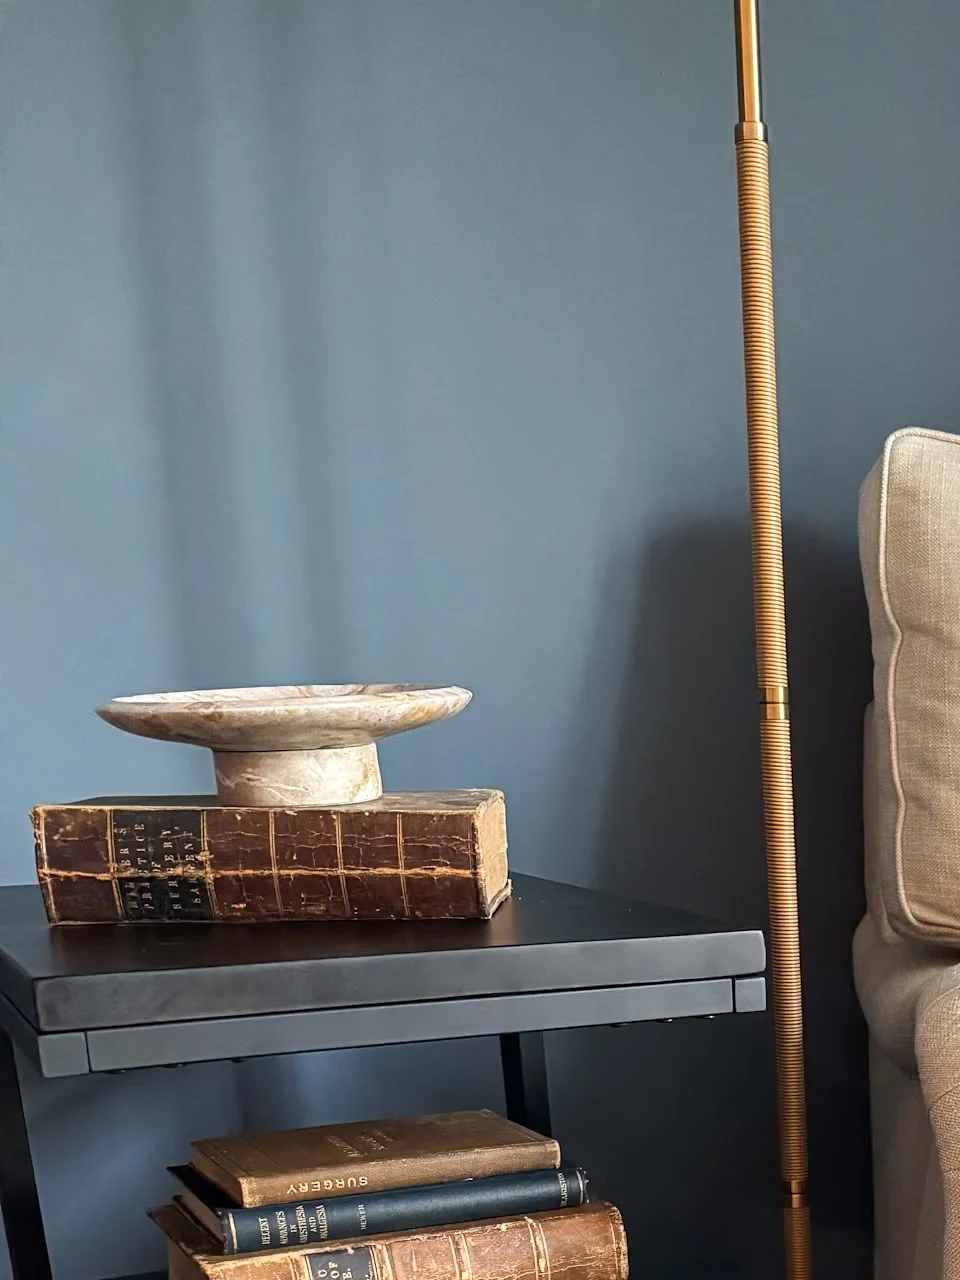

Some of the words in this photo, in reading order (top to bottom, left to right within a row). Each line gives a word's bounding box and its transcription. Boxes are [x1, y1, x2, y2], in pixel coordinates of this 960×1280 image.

[286, 1175, 369, 1196] SURGERY
[258, 1217, 271, 1246] RECENT
[289, 1224, 298, 1234] IN
[308, 1216, 317, 1233] AND
[328, 1261, 340, 1280] OF
